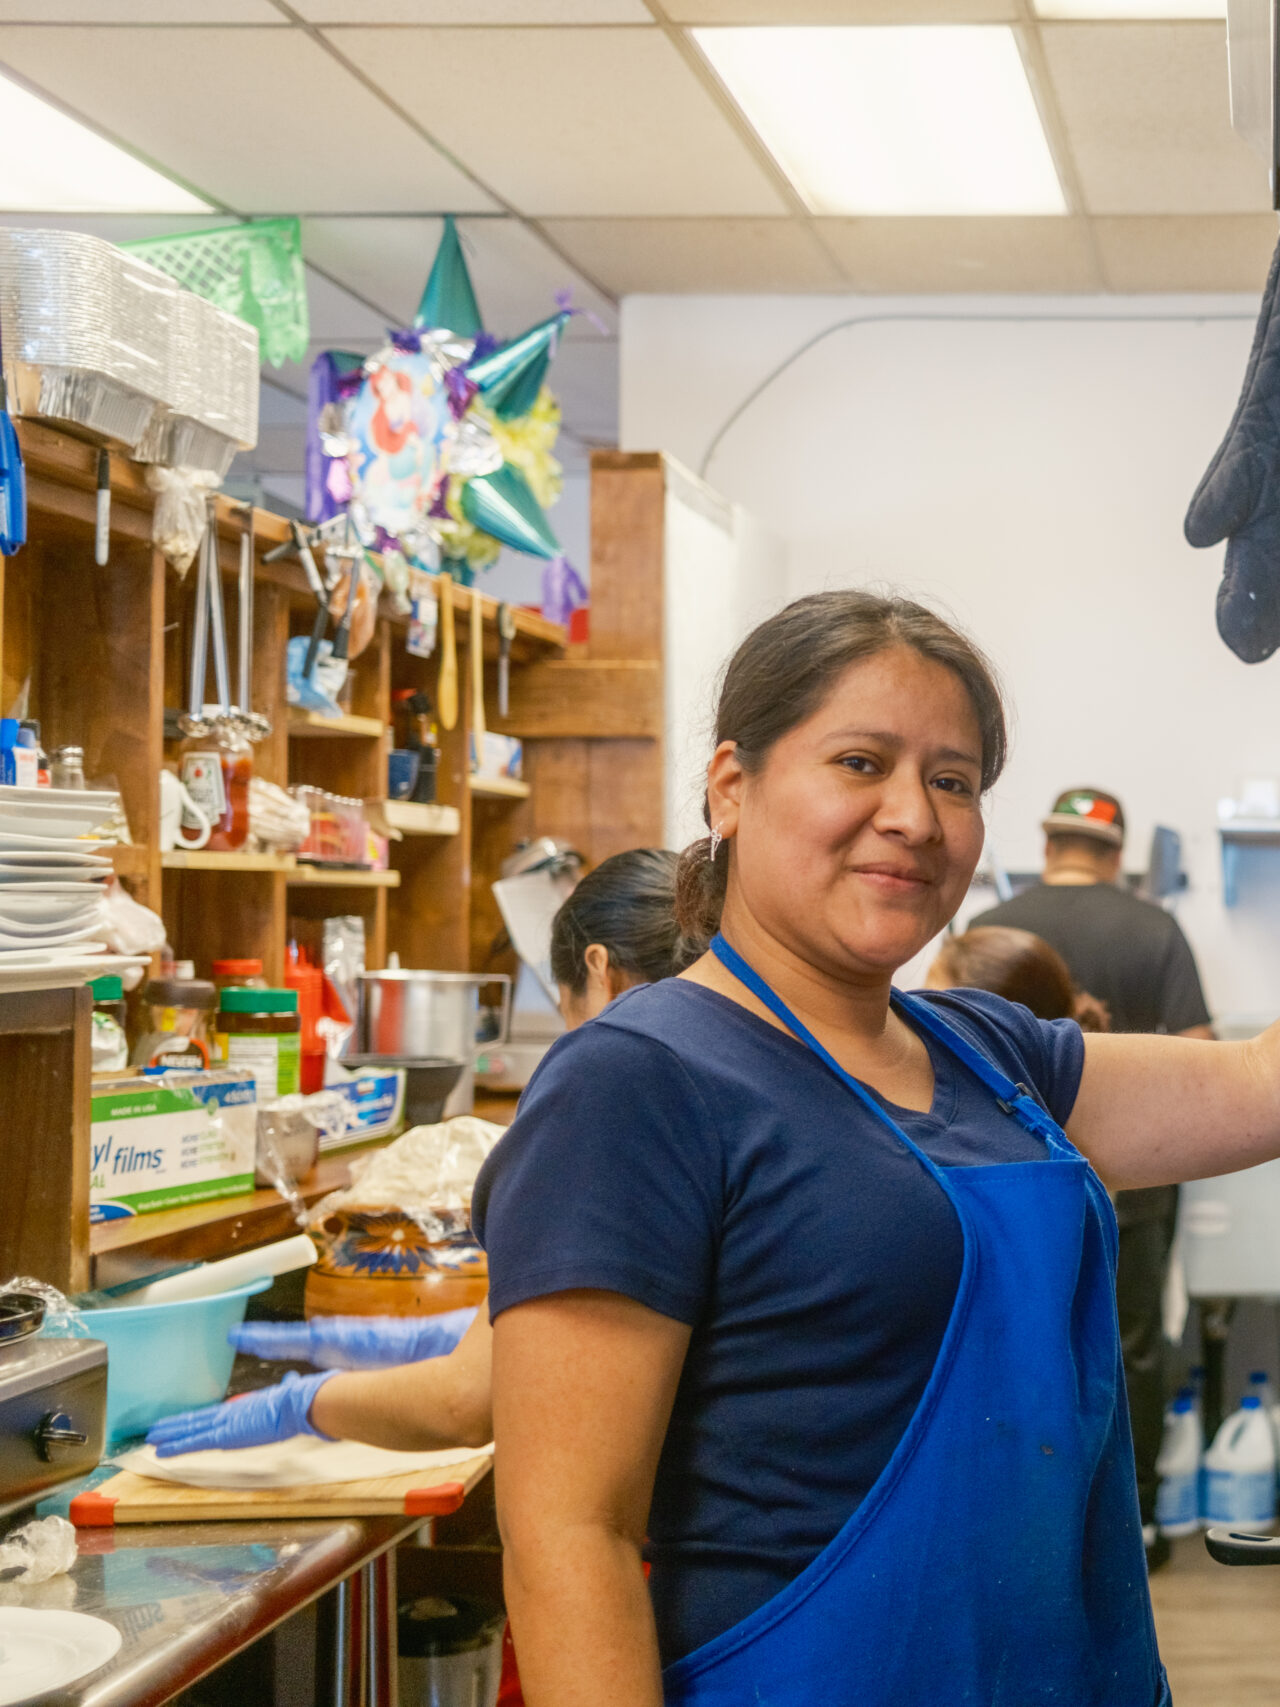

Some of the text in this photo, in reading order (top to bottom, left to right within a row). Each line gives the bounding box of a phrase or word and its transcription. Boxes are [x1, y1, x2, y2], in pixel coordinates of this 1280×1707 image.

[110, 1103, 157, 1116] MADE IN USA
[113, 1146, 163, 1175] films
